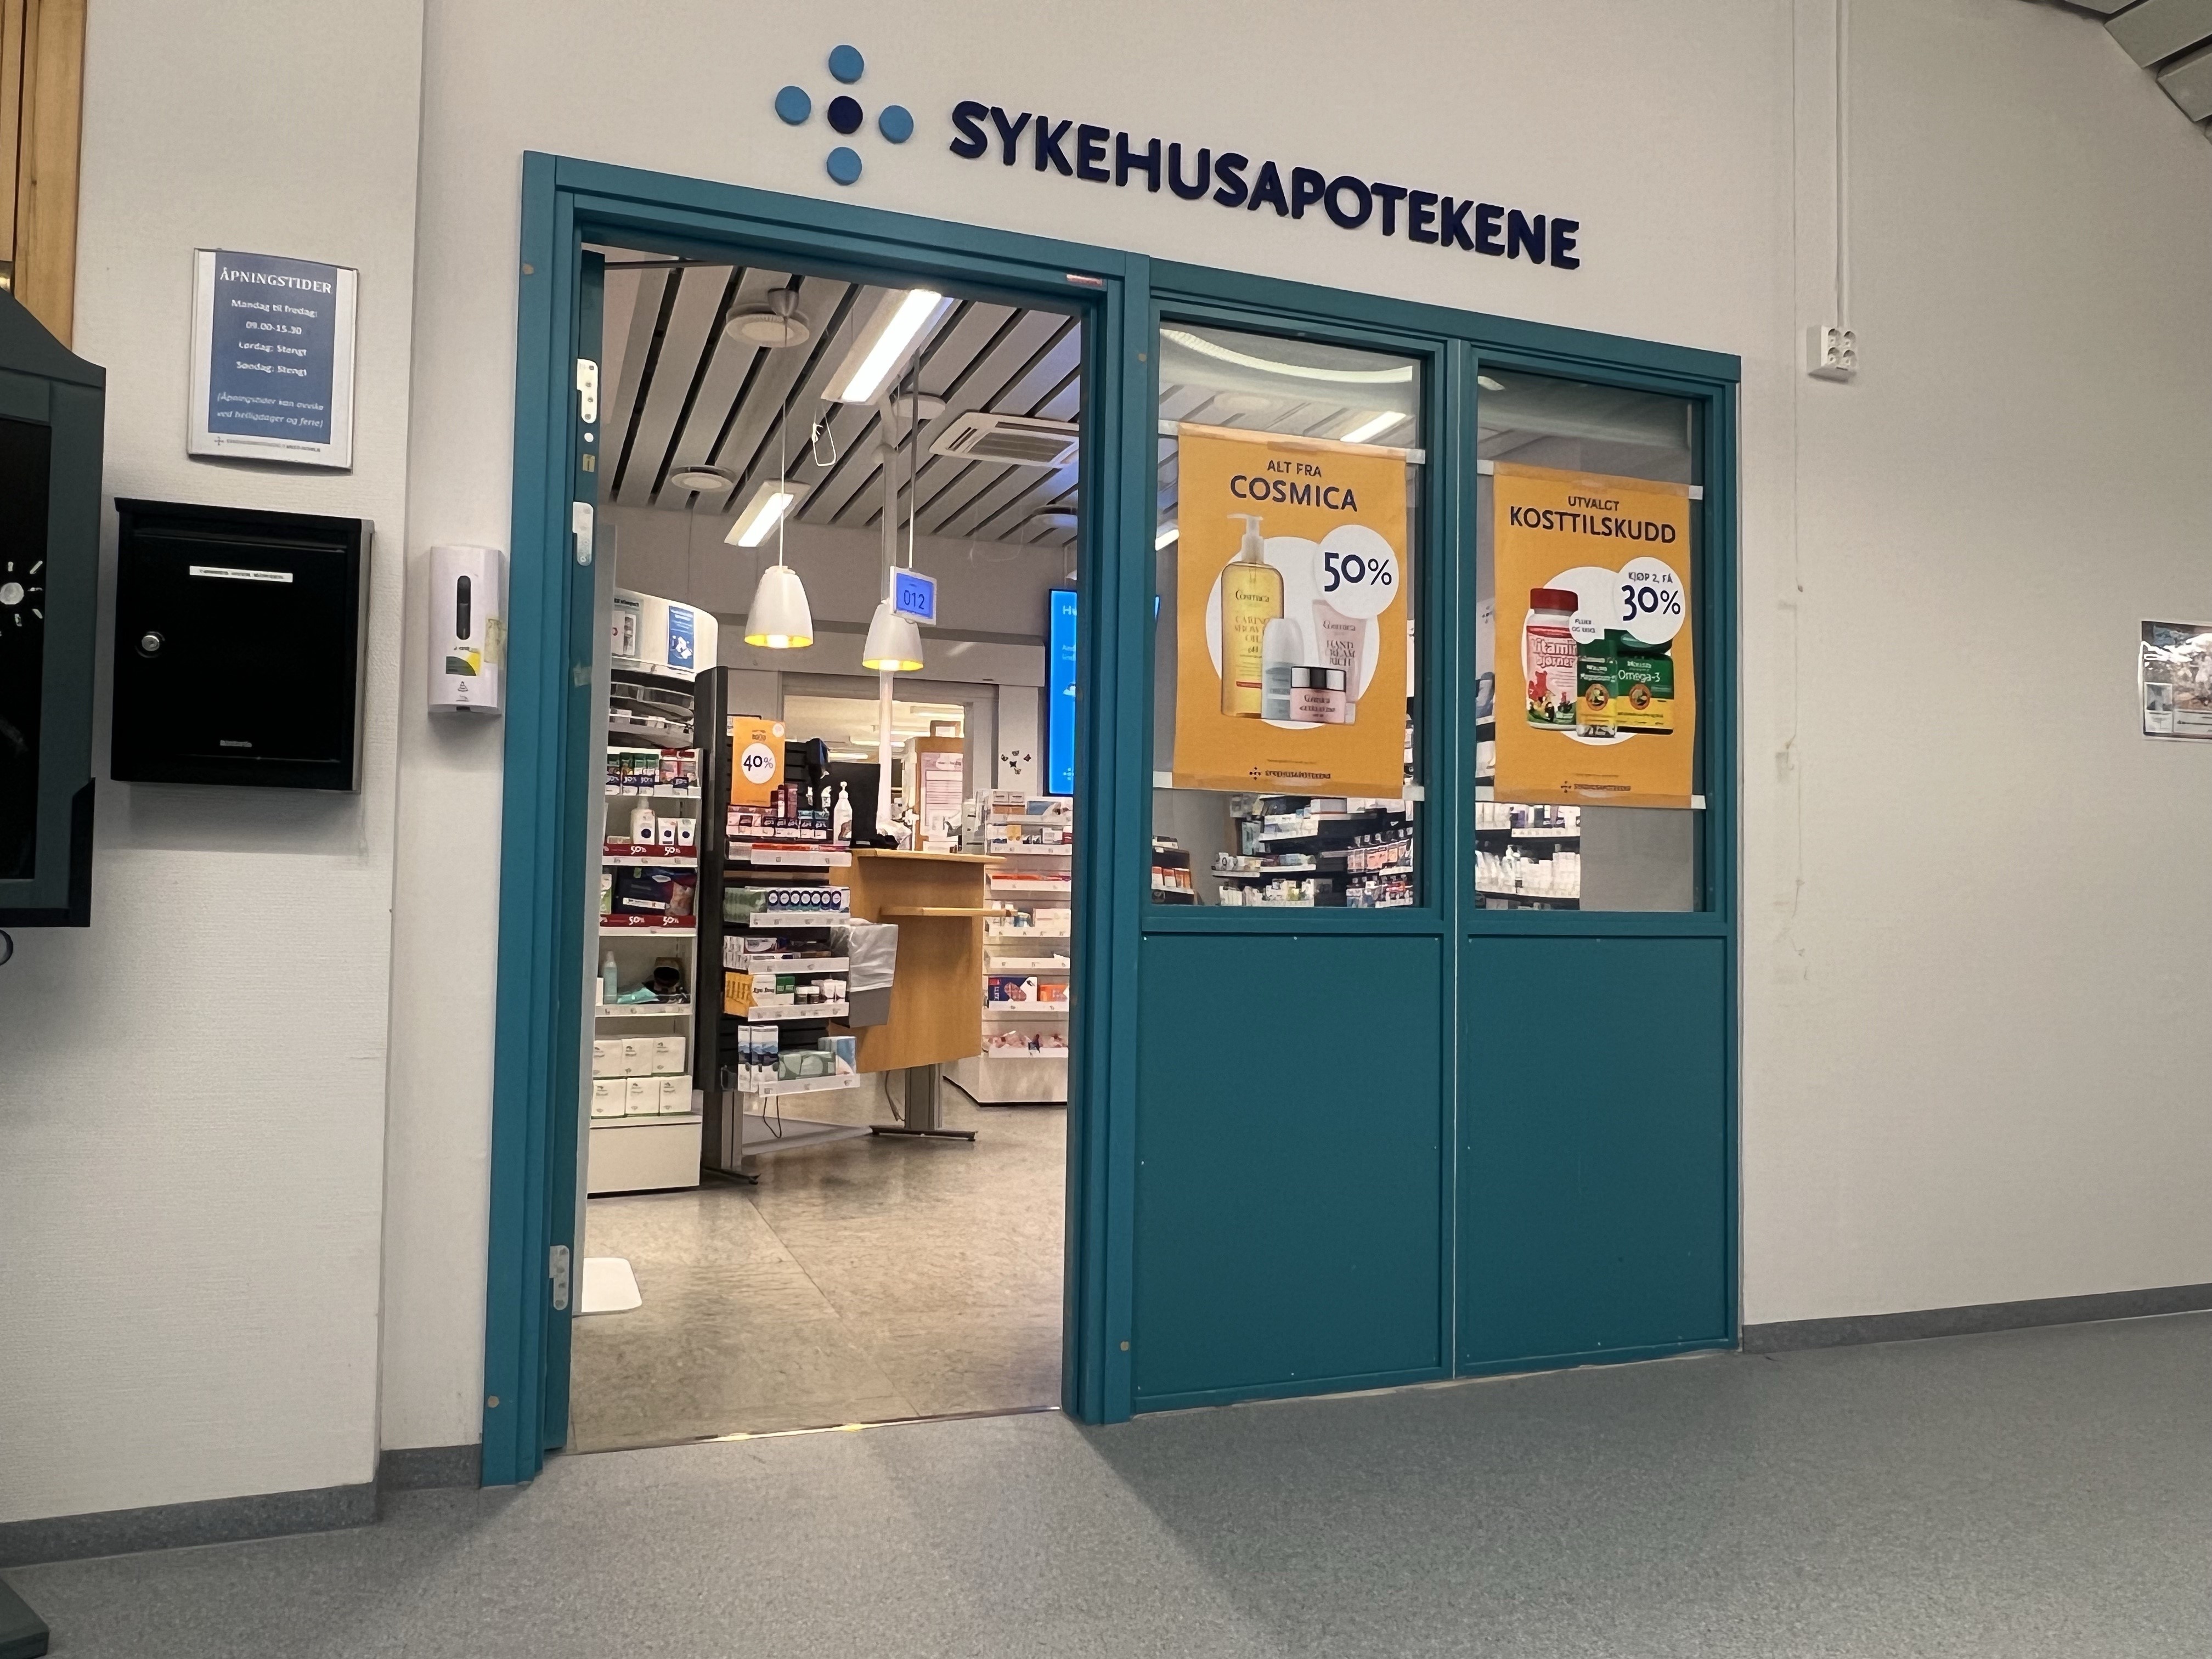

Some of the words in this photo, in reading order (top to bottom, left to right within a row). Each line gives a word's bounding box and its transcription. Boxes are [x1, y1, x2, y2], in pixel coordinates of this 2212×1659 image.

[950, 101, 1580, 270] SYKEHUSAPOTEKENE
[220, 267, 331, 294] ÅPNINGSTIDER
[232, 300, 269, 312] Mandag
[273, 304, 282, 312] til
[1267, 460, 1292, 474] ALT
[1296, 463, 1322, 477] FRA
[1230, 475, 1358, 512] COSMICA
[1568, 496, 1620, 511] UTVALGT
[1510, 506, 1676, 544] KOSTTILSKUDD
[1324, 552, 1392, 592] 50%
[904, 590, 925, 610] 012
[1621, 585, 1681, 621] 30%
[1618, 669, 1661, 683] Omega-3
[743, 754, 774, 772] 40%
